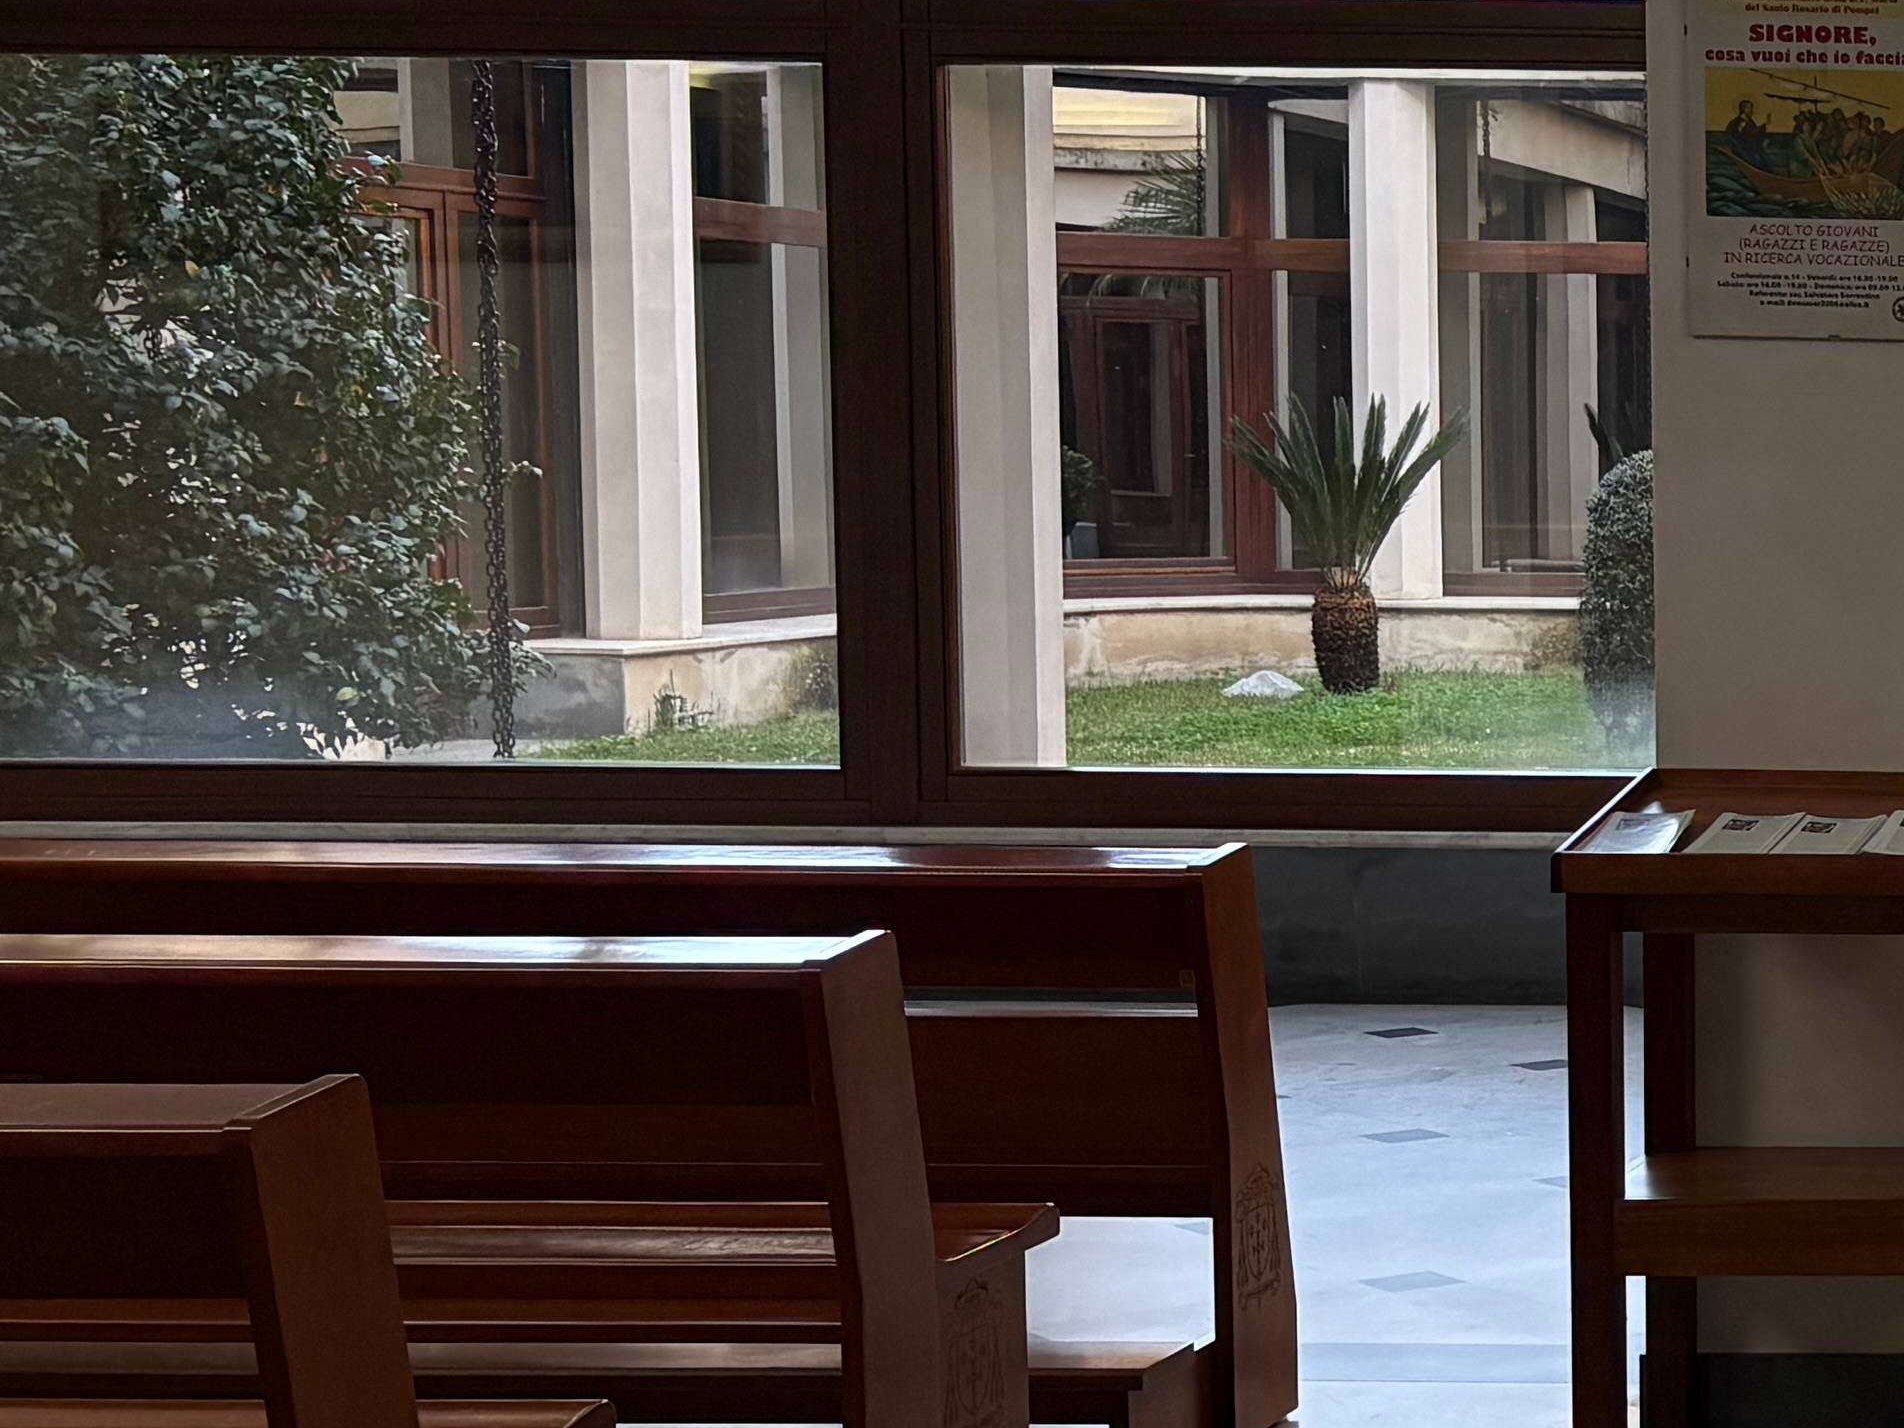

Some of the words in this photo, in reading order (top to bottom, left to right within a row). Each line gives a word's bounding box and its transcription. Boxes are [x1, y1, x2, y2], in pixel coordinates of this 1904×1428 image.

[1745, 3, 1759, 12] del
[1832, 5, 1841, 14] di
[1749, 24, 1877, 46] SIGNORE,
[1705, 49, 1745, 63] cosa
[1751, 49, 1791, 63] vuoi
[1796, 49, 1828, 63] che
[1833, 50, 1850, 64] io
[1750, 224, 1812, 236] ASCOLTO
[1817, 226, 1879, 237] GIOVANI
[1739, 238, 1805, 251] (RAGAZZI
[1810, 239, 1818, 250] E
[1822, 240, 1890, 253] RAGAZZE)
[1724, 252, 1741, 263] IN
[1745, 253, 1802, 265] RICERCA
[1807, 255, 1904, 267] VOCAZIONALE
